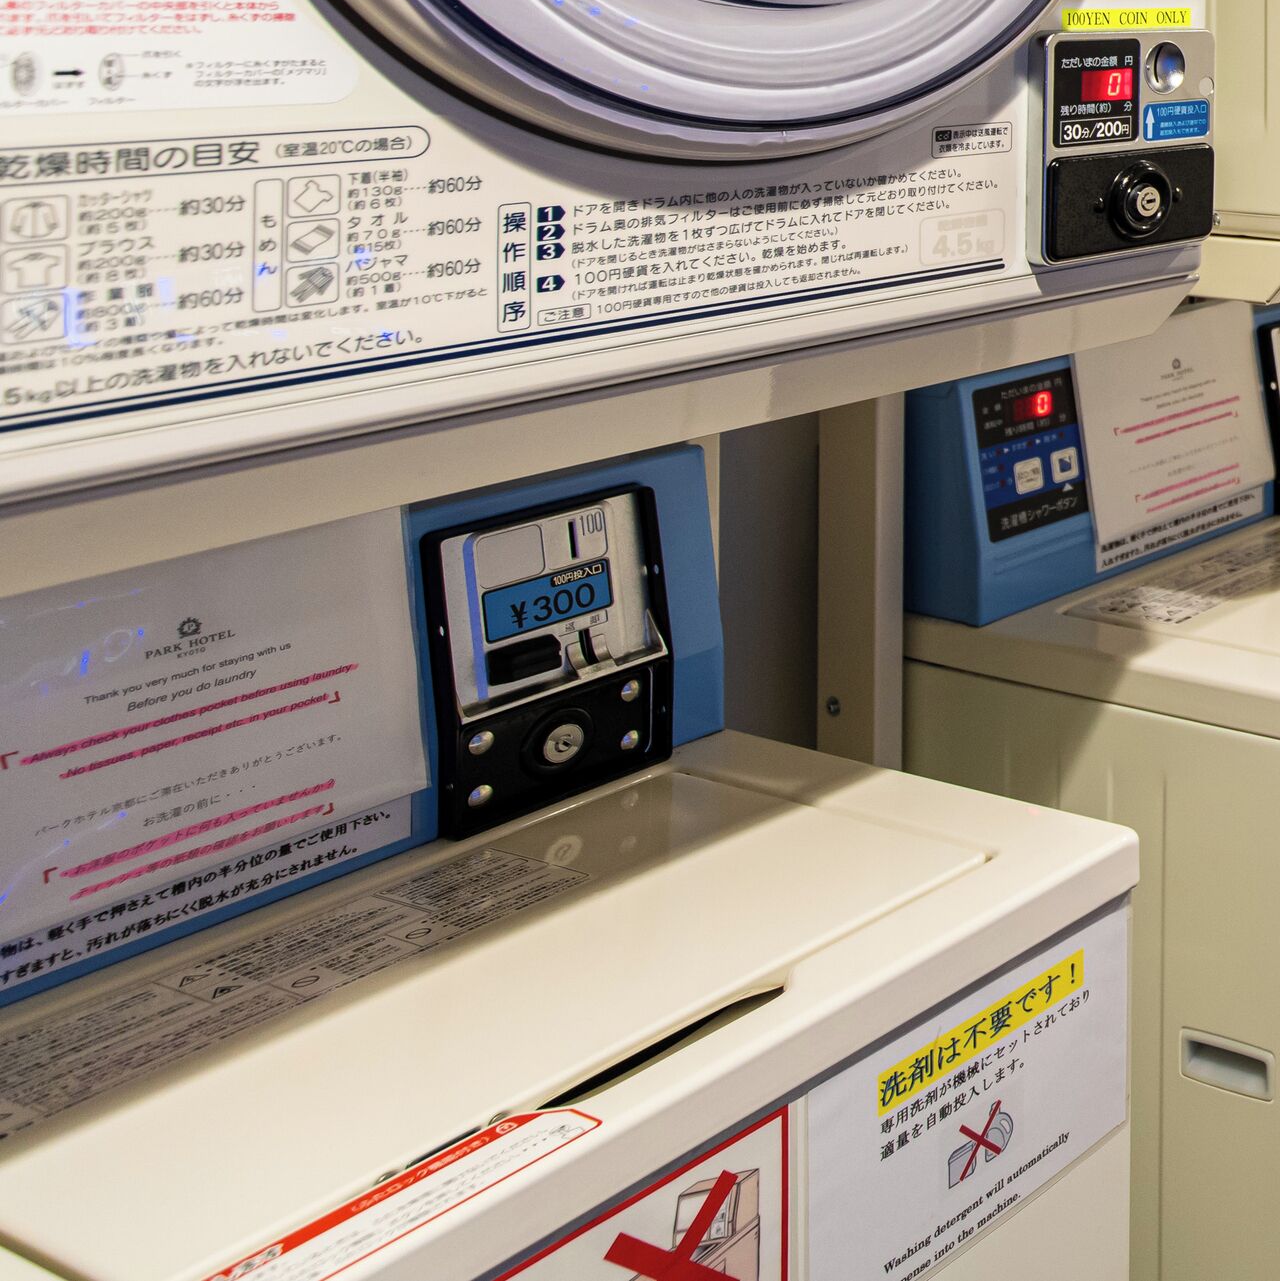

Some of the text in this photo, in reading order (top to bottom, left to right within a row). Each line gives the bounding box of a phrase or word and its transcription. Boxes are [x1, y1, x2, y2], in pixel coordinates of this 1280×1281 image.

[1067, 11, 1187, 26] 100YEN COIN ONLY
[1061, 55, 1133, 69] ただいまの金額 円
[1107, 73, 1121, 96] 0
[1124, 102, 1132, 112] 分
[1064, 121, 1130, 140] 30分/200円
[428, 175, 482, 195] 約60分
[178, 195, 246, 216] 約30分
[348, 212, 408, 229] タオル
[427, 217, 482, 236] 約60分
[178, 242, 245, 263] 約30分
[258, 214, 277, 276] もめん
[427, 258, 481, 278] 約60分
[503, 211, 526, 323] 操作順序
[178, 288, 244, 310] 約60分
[1037, 393, 1049, 415] 0
[579, 511, 603, 536] 100
[553, 564, 602, 586] 100円投入口
[510, 583, 595, 628] ¥300
[145, 629, 236, 660] PARK HOTEL
[177, 647, 206, 658] KYOTO
[84, 643, 292, 705] Thank you very much for staying with us
[127, 669, 257, 713] Before you do laundry
[31, 664, 352, 765] Always check your clothes pocket before using laundry
[67, 766, 85, 777] No
[141, 738, 178, 756] paper,
[182, 724, 222, 744] receipt
[249, 713, 260, 723] in
[262, 705, 287, 721] your
[289, 693, 328, 711] pocket
[880, 962, 1077, 1107] 洗剤は不要です！
[880, 989, 1090, 1135] 専用洗剤が機械にセットされており
[880, 1058, 1025, 1162] 適量を自動投入します。
[883, 1131, 1070, 1274] Washing detergent will automatically
[900, 1192, 1021, 1281] pense into the machine.
